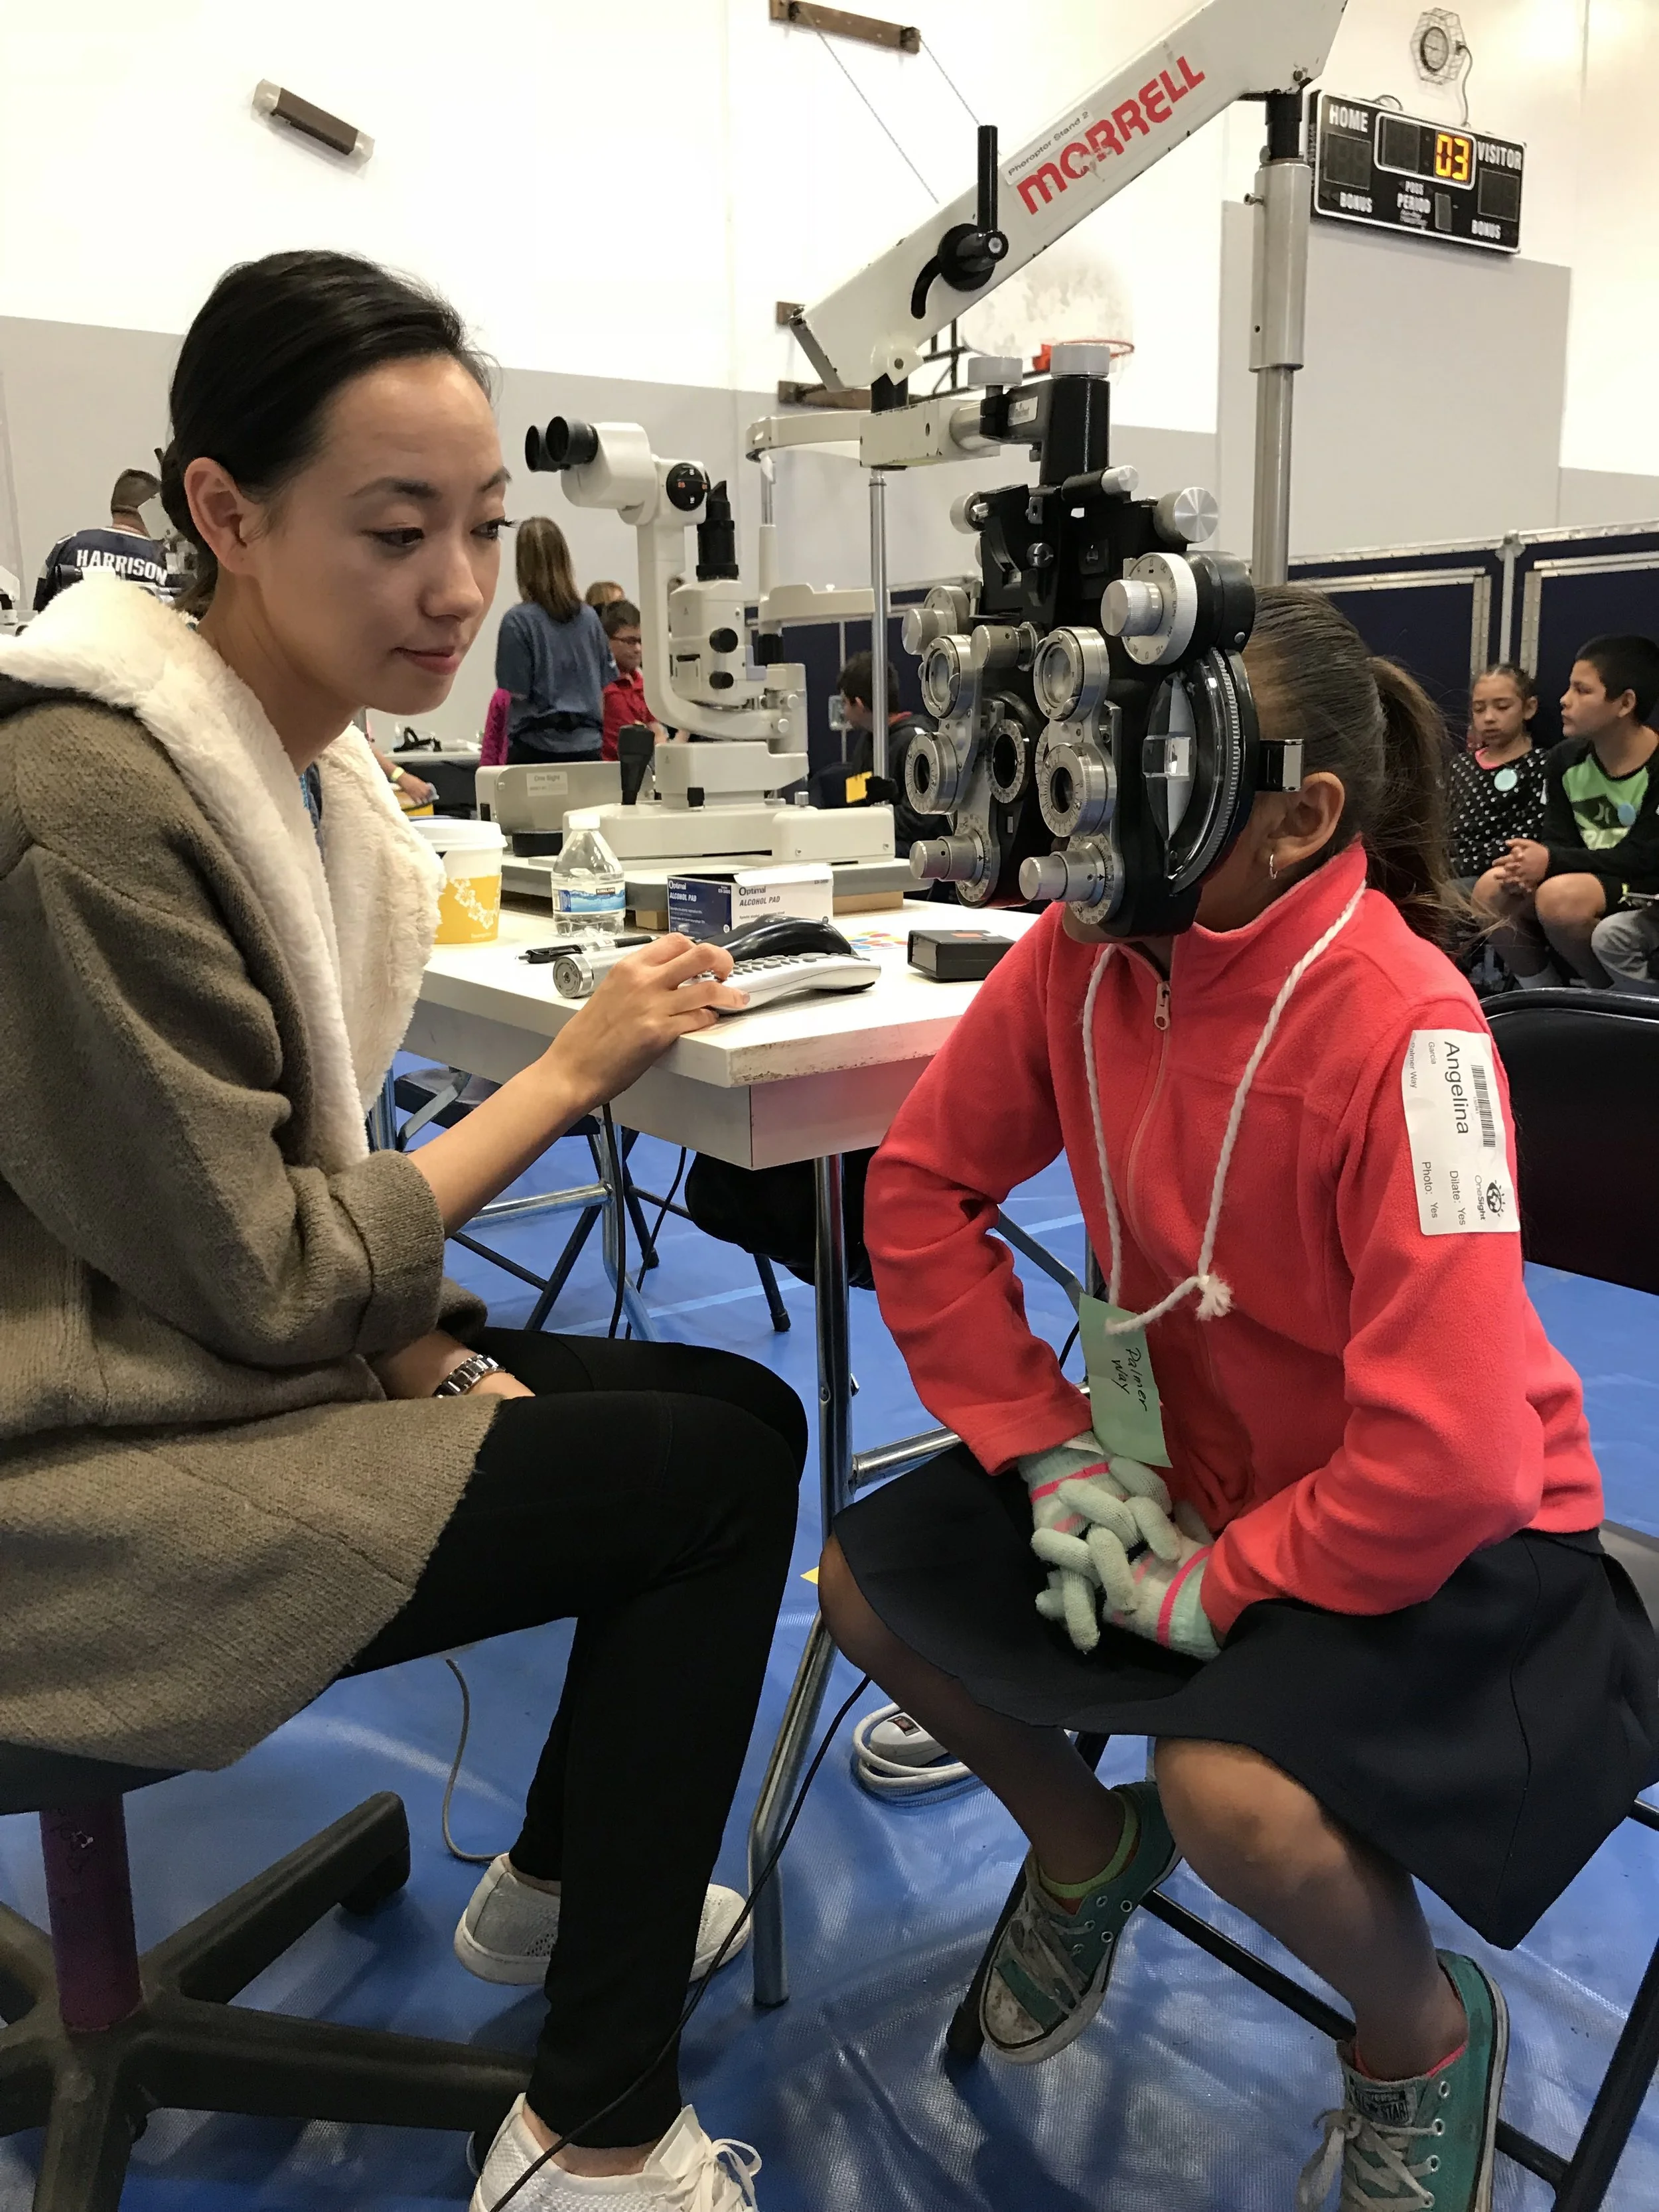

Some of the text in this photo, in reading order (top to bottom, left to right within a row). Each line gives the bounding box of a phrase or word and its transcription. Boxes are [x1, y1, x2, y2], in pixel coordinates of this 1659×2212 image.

[1329, 104, 1369, 133] HOME
[1008, 111, 1089, 176] Phoroptor Stand 2
[1435, 133, 1469, 181] 03
[1477, 141, 1523, 171] VISITOR
[76, 549, 168, 586] HARRISON
[668, 880, 687, 890] Optimal
[738, 885, 766, 896] Optimal
[739, 895, 781, 907] ALCOHOL PAD
[1427, 1041, 1437, 1065] Garcia
[1444, 1041, 1469, 1134] Angelina
[1422, 1161, 1433, 1195] Photo:
[1449, 1170, 1466, 1226] Dilate: Yes
[1474, 1175, 1486, 1220] OneSight
[1110, 1359, 1130, 1394] Way
[1125, 1347, 1147, 1412] Palmer
